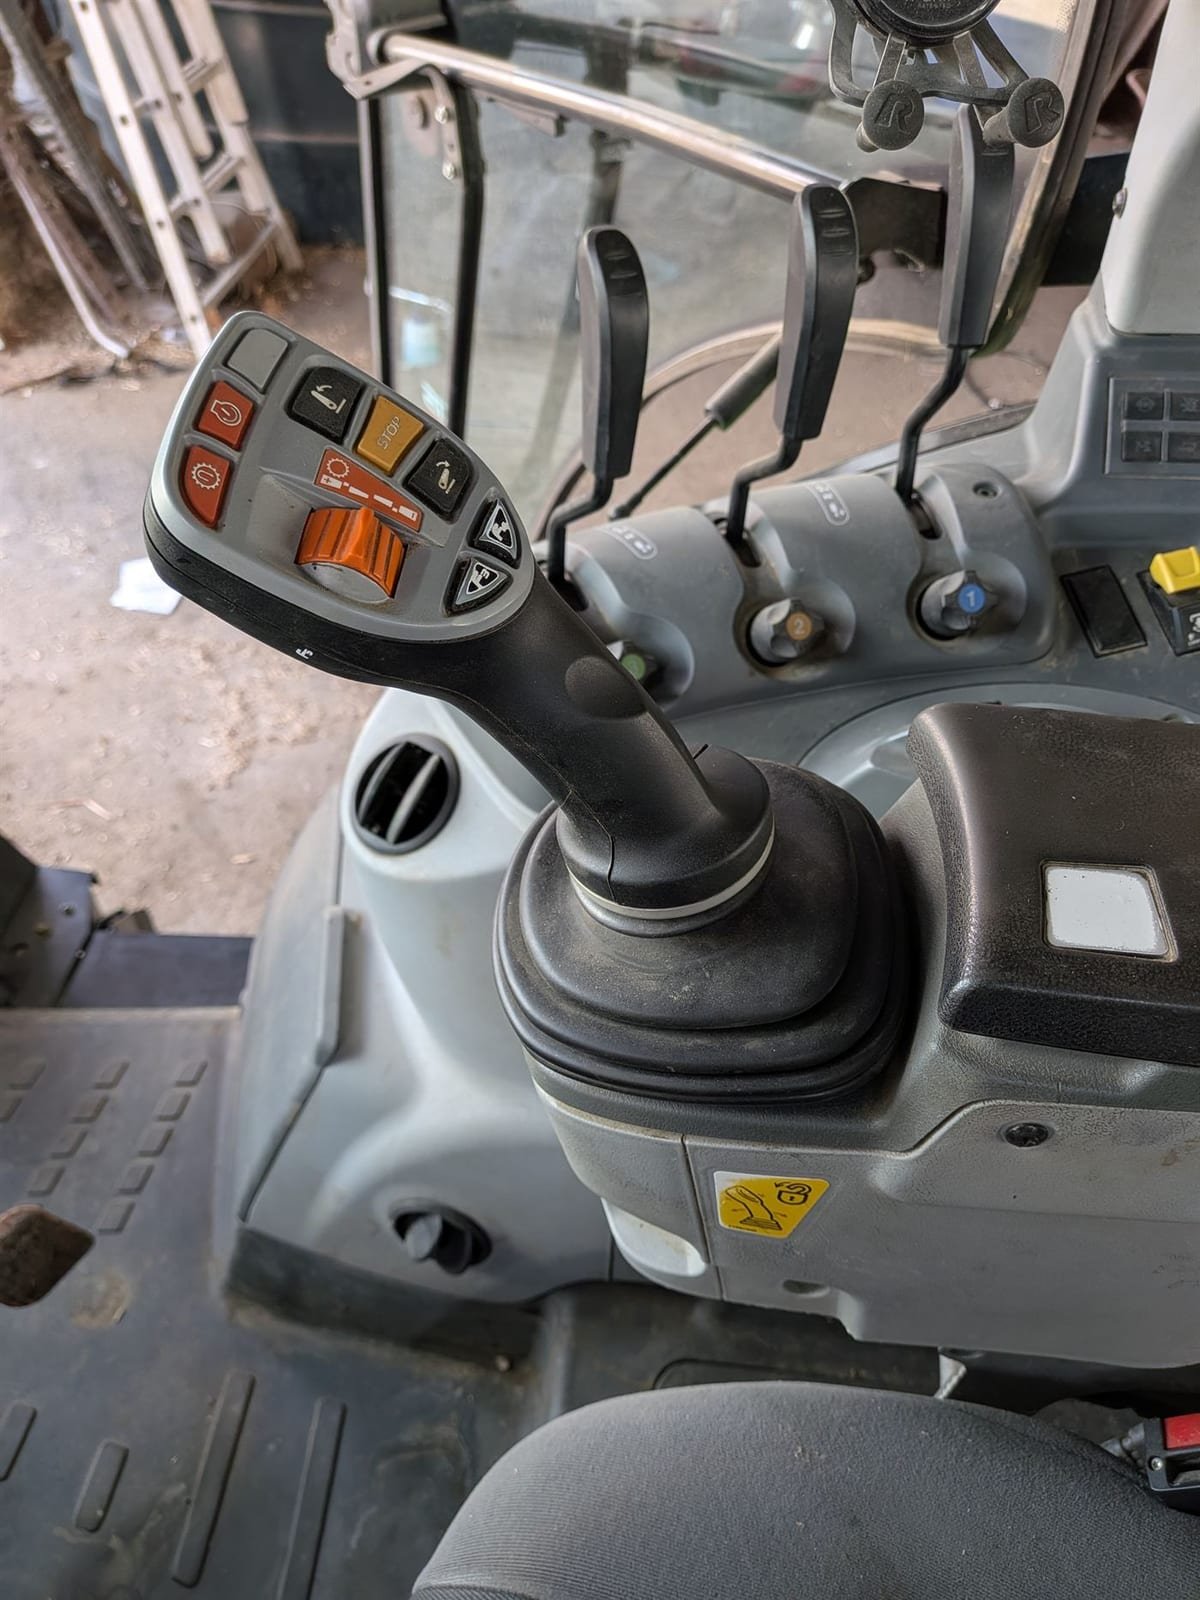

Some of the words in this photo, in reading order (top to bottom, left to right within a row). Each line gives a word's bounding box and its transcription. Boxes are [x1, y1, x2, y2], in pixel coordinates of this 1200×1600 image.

[377, 416, 400, 450] STOP
[965, 591, 975, 608] 1
[793, 618, 806, 635] 2
